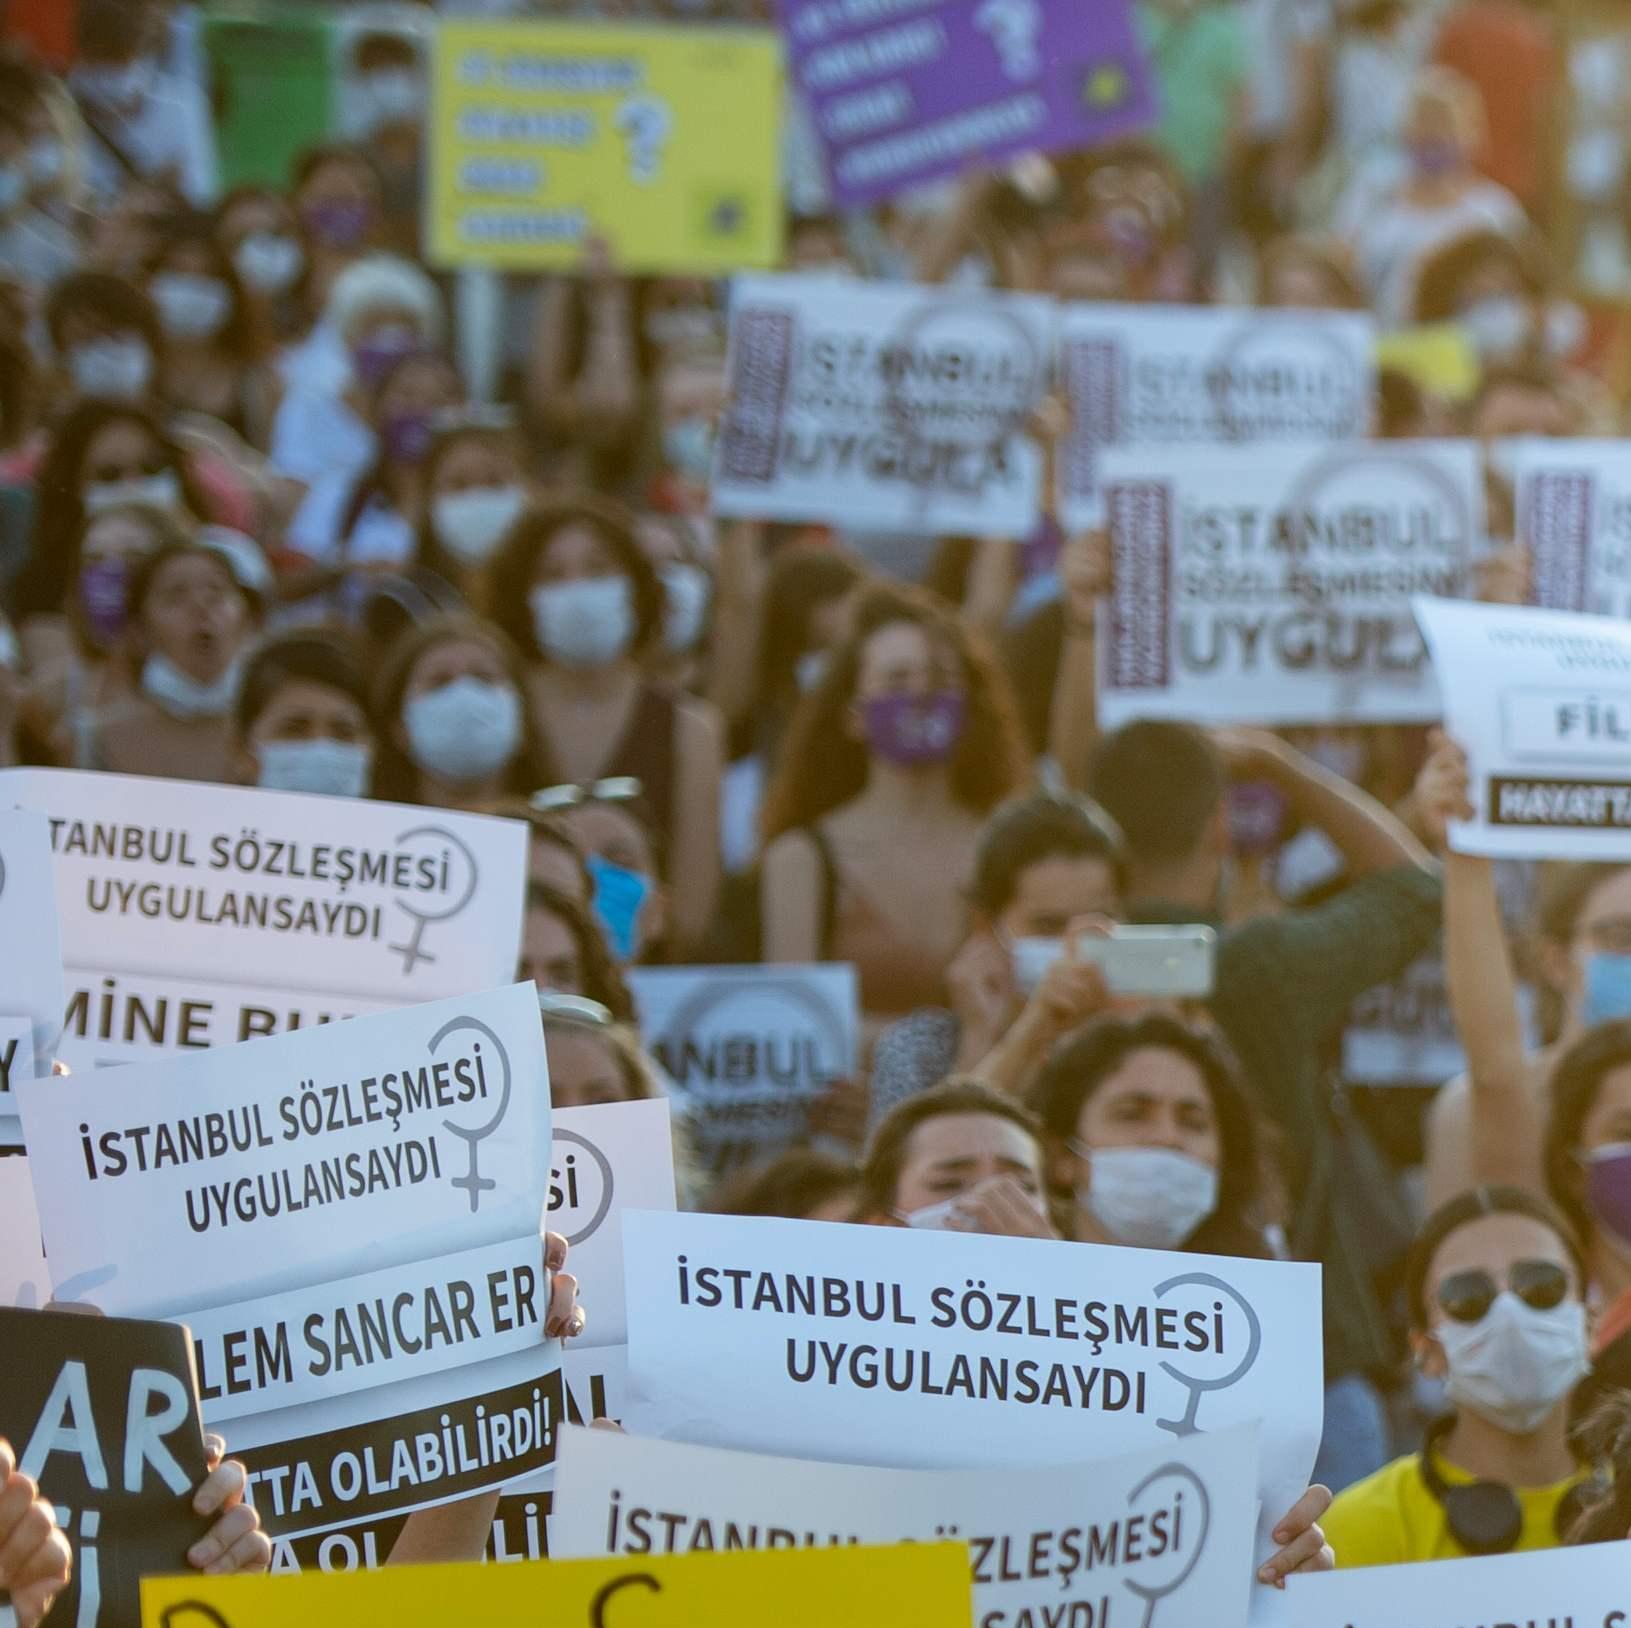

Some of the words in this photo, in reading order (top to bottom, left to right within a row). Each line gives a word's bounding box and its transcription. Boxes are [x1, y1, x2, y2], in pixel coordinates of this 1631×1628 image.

[86, 876, 383, 940] UYGULANSAYDI
[209, 829, 451, 893] SÖZLEŞMESİ
[79, 1110, 274, 1181] İSTANBUL
[279, 1042, 489, 1134] SÖZLEŞMESİ
[185, 1135, 442, 1233] UYGULANSAYDI
[195, 1320, 294, 1404] LEM
[303, 1279, 484, 1378] SANCAR
[487, 1263, 540, 1336] ER
[676, 1254, 917, 1326] İSTANBUL
[929, 1278, 1226, 1356] SÖZLEŞMESİ
[785, 1337, 1147, 1415] UYGULANSAYDI
[240, 1462, 324, 1519] TTA
[330, 1387, 553, 1502] OLABİLİRDİ!
[605, 1489, 860, 1556] İSTAN
[930, 1490, 1184, 1592] ZLEŞMESİ
